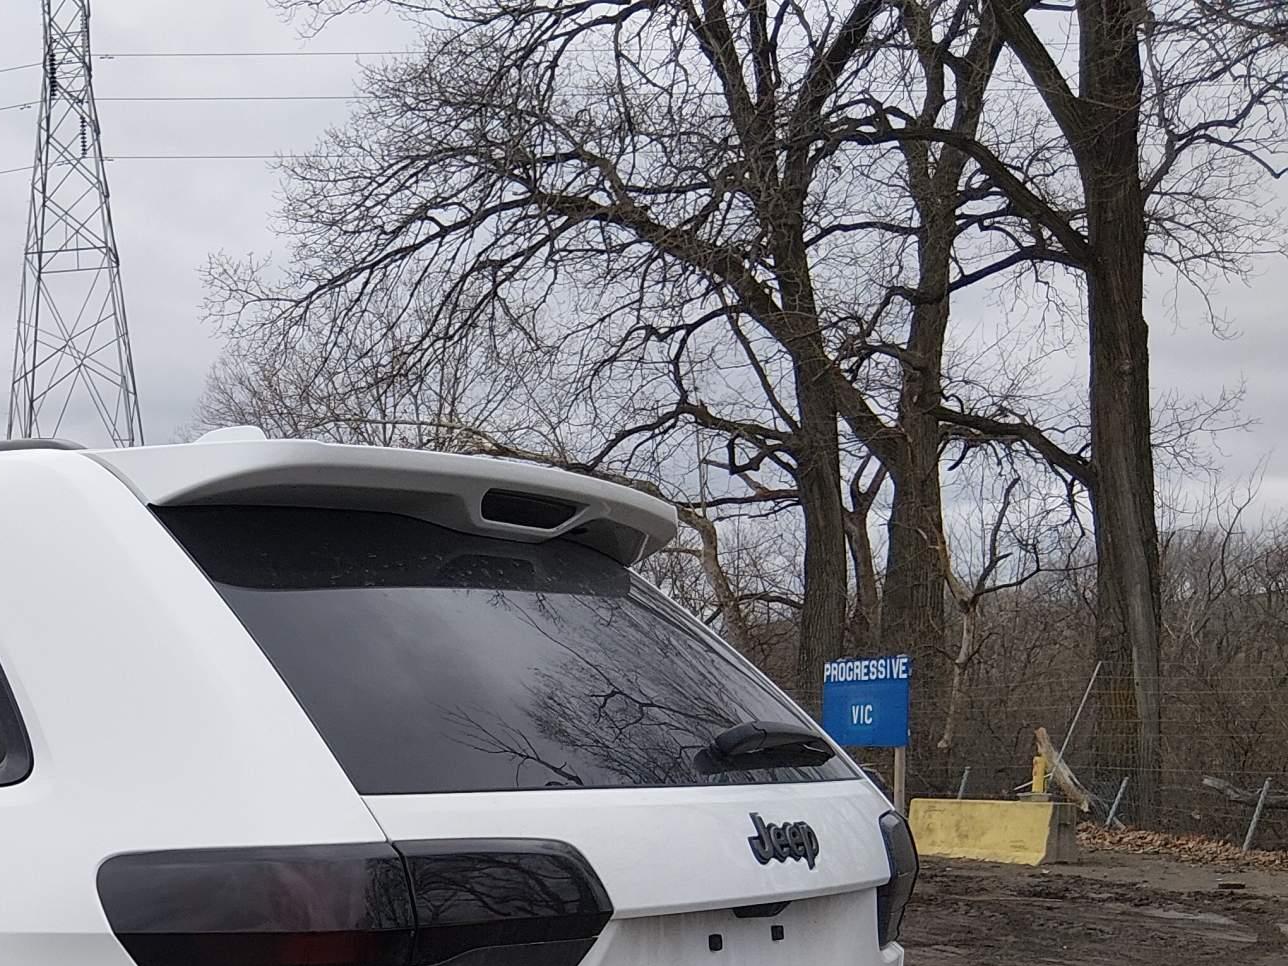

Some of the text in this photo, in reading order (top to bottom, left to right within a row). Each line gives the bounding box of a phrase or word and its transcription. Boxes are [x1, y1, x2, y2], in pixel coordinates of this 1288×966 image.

[824, 658, 908, 683] PROGRESSIVE
[852, 704, 873, 724] VIC
[747, 811, 820, 870] Jeep
